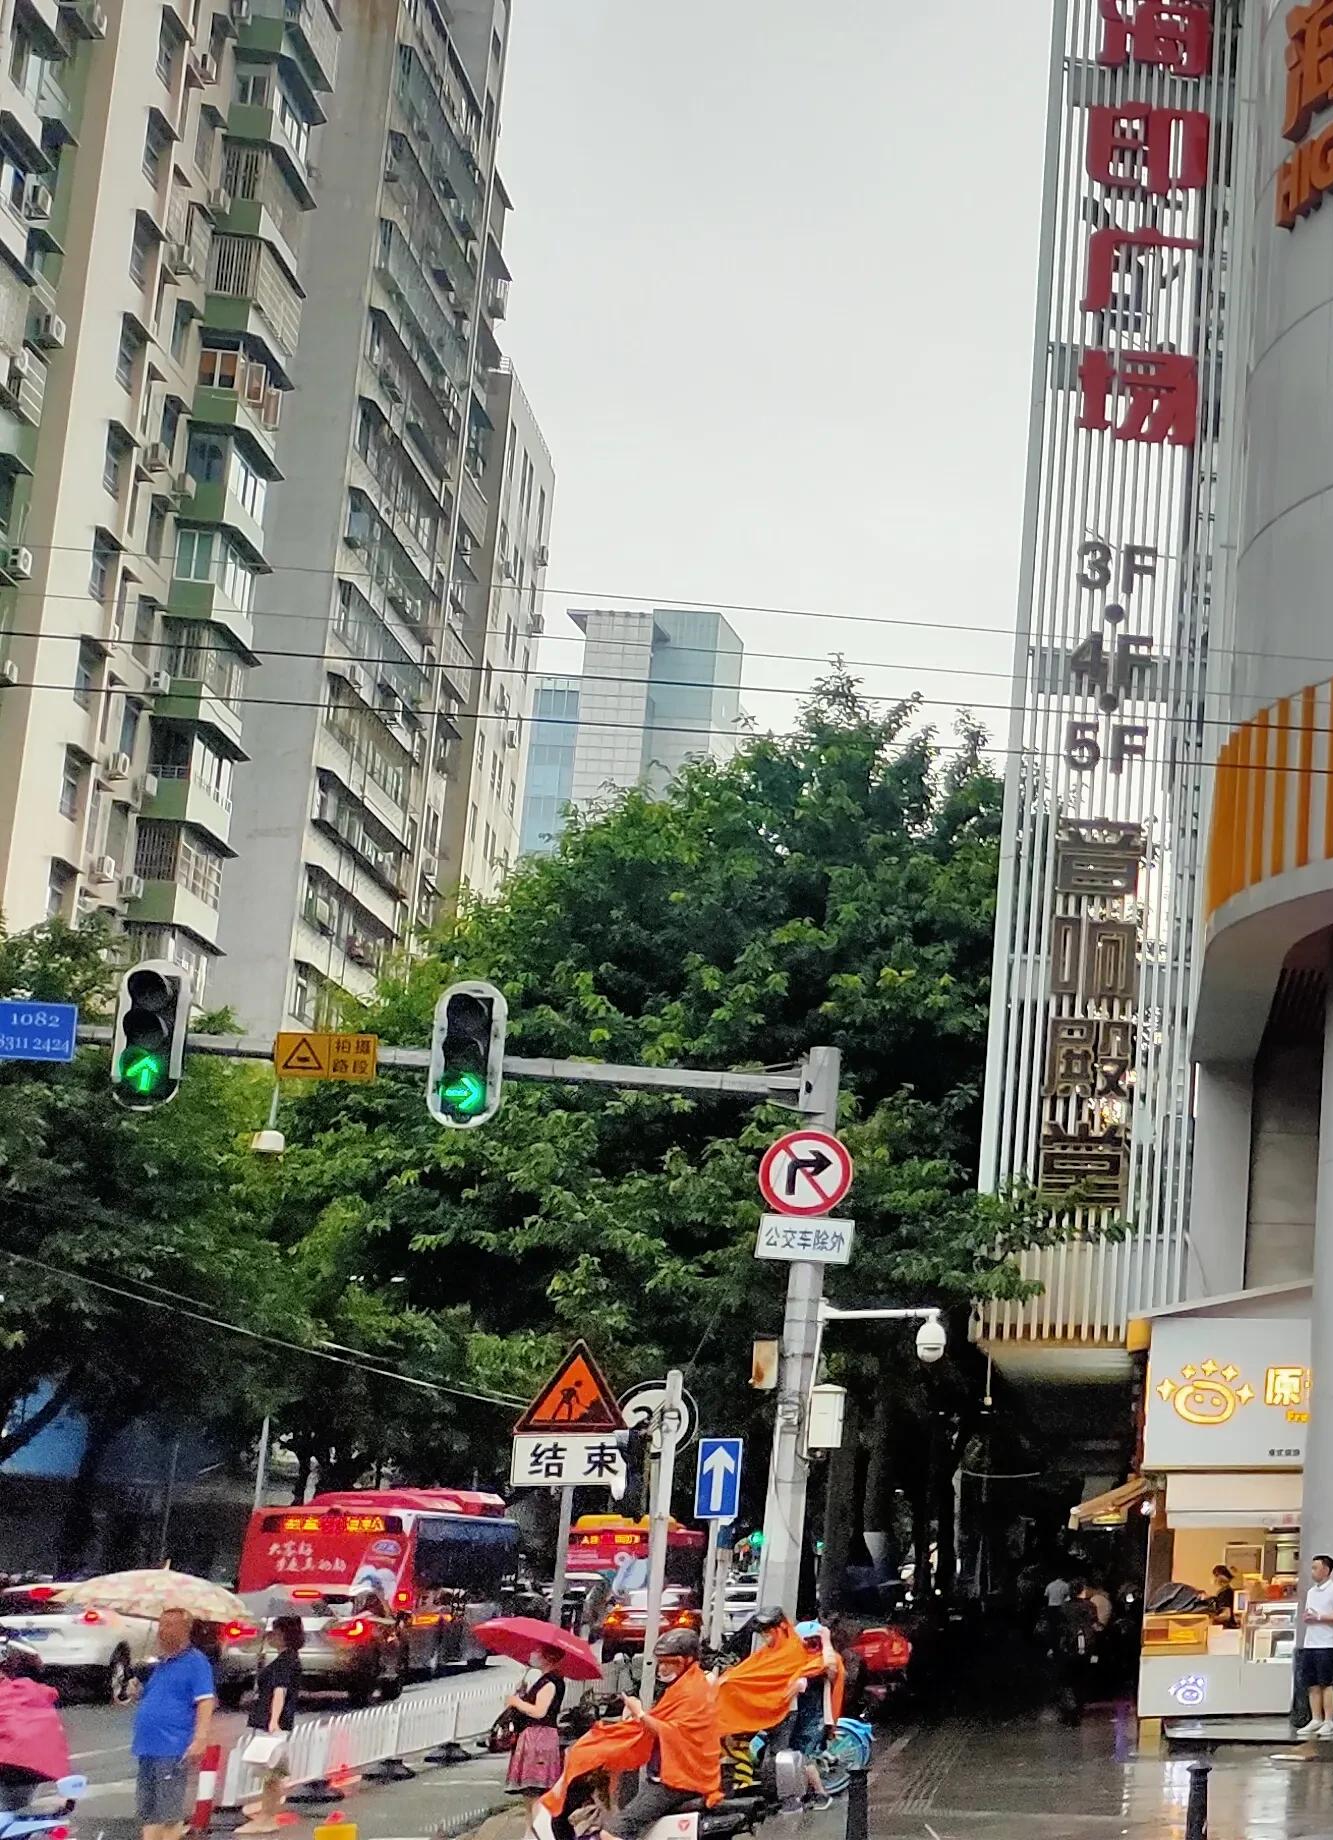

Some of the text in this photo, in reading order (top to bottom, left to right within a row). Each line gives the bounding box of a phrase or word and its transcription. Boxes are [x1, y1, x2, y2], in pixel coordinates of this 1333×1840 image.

[1062, 541, 1157, 775] 3F 4F 5F
[10, 1010, 61, 1028] 1082
[32, 1037, 70, 1054] 2424
[335, 1038, 371, 1054] 拍摄
[332, 1058, 369, 1075] 路段
[765, 1225, 845, 1254] 公交车除外
[527, 1441, 620, 1479] 结束
